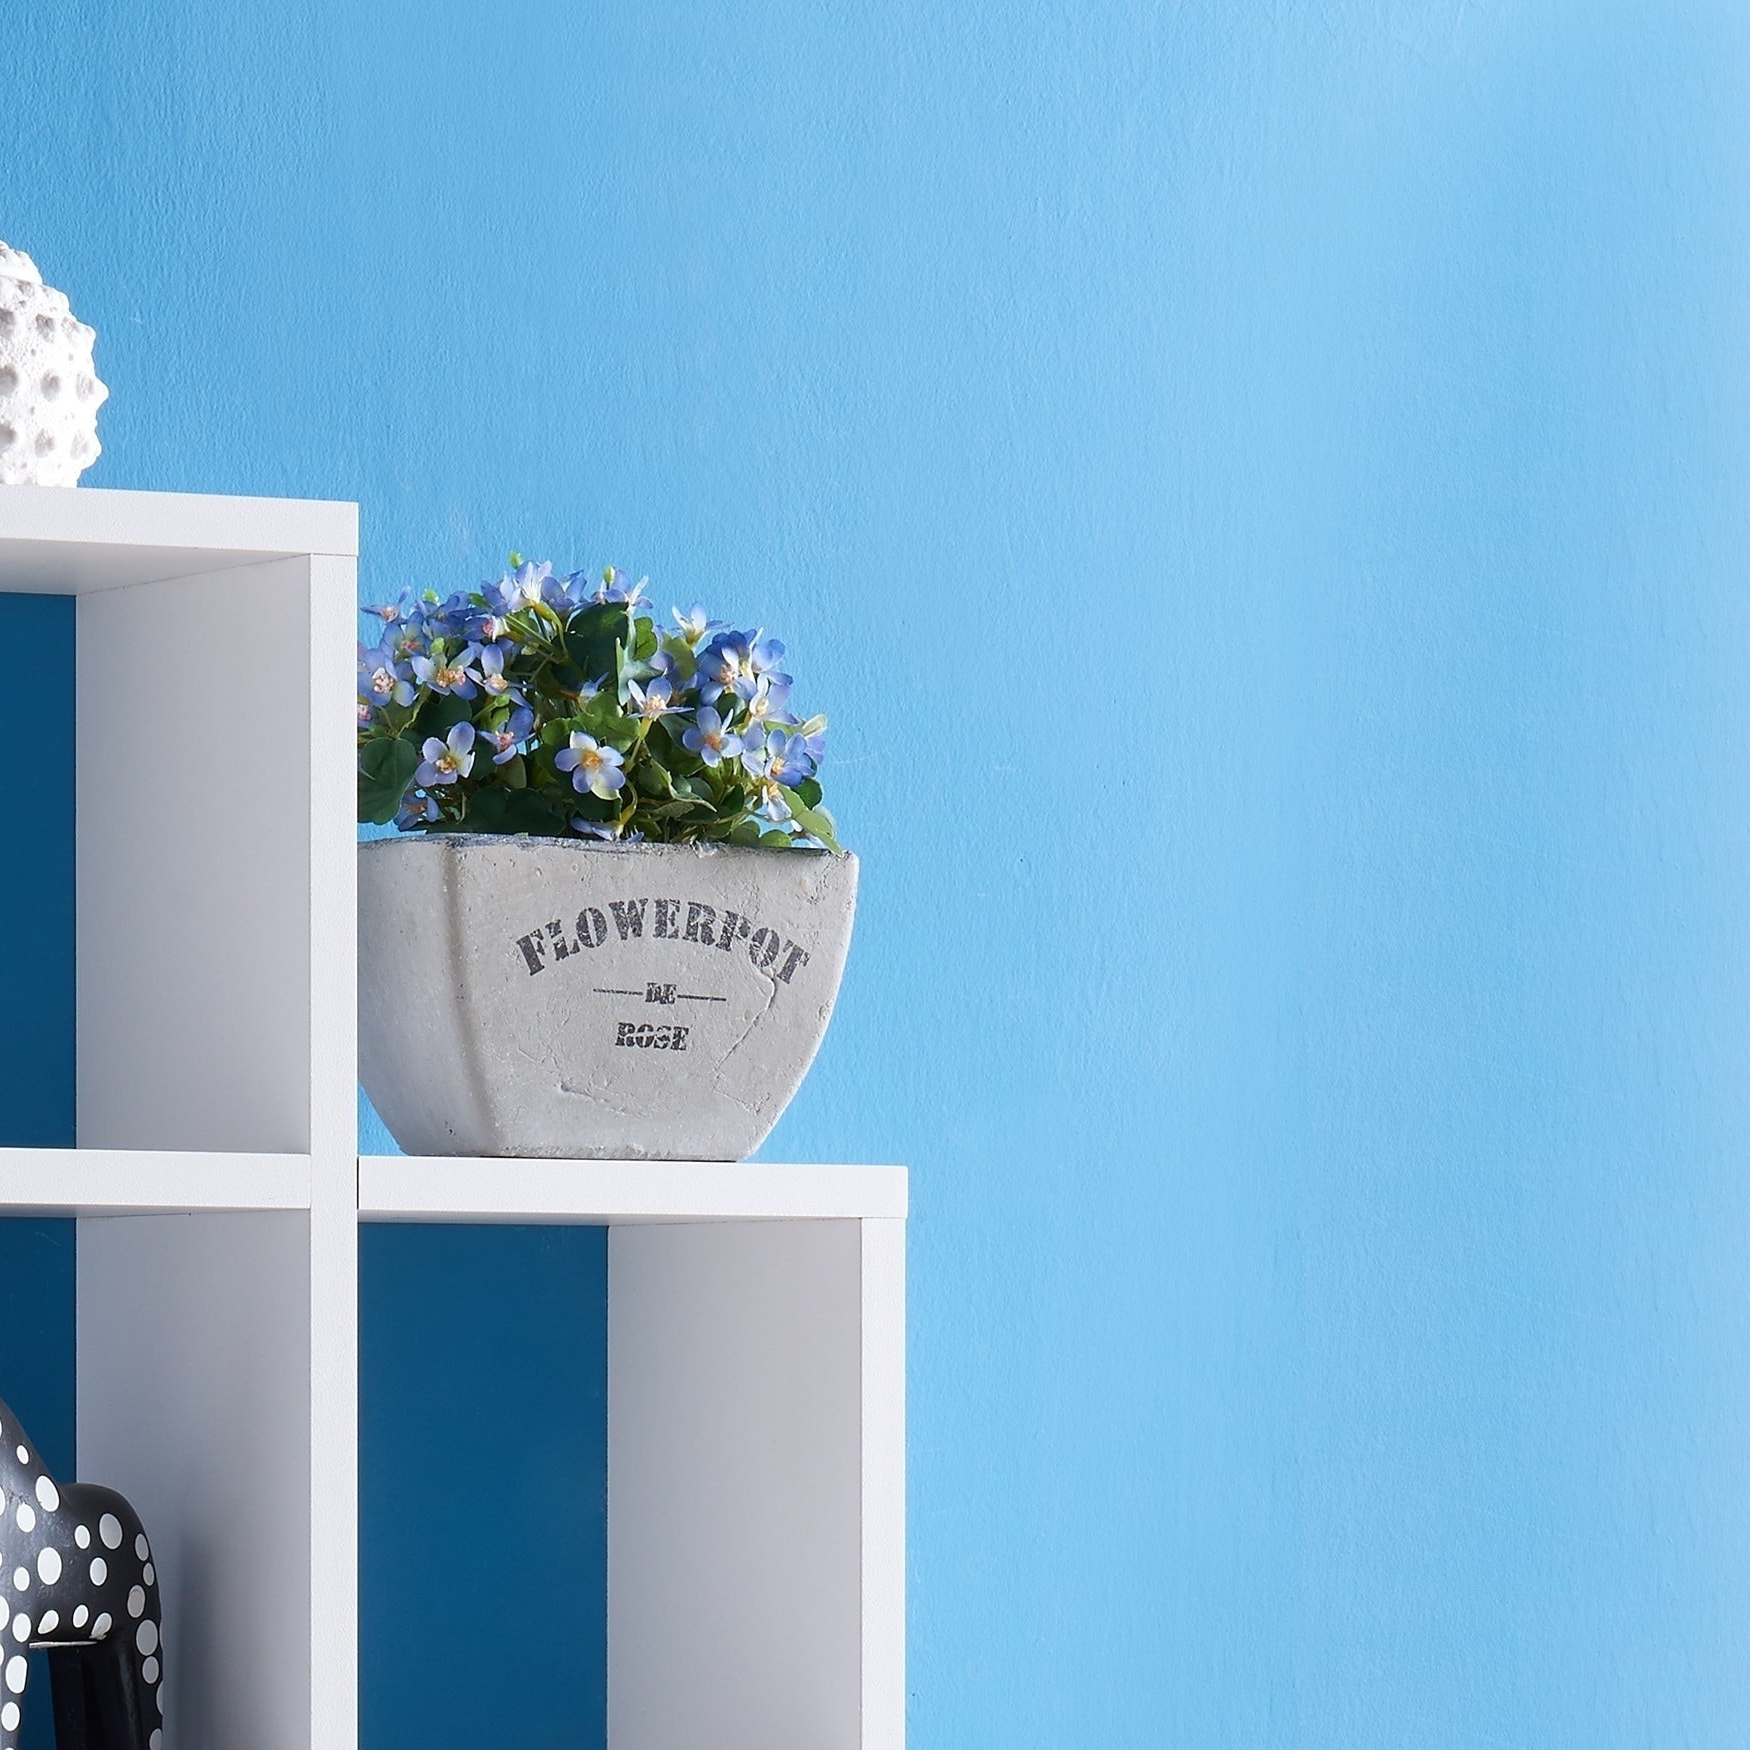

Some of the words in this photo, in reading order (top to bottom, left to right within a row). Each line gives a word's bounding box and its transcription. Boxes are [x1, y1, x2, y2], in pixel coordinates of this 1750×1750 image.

[516, 898, 810, 984] FLOWERPOT
[645, 982, 677, 1004] DE
[615, 1022, 689, 1050] ROSE
